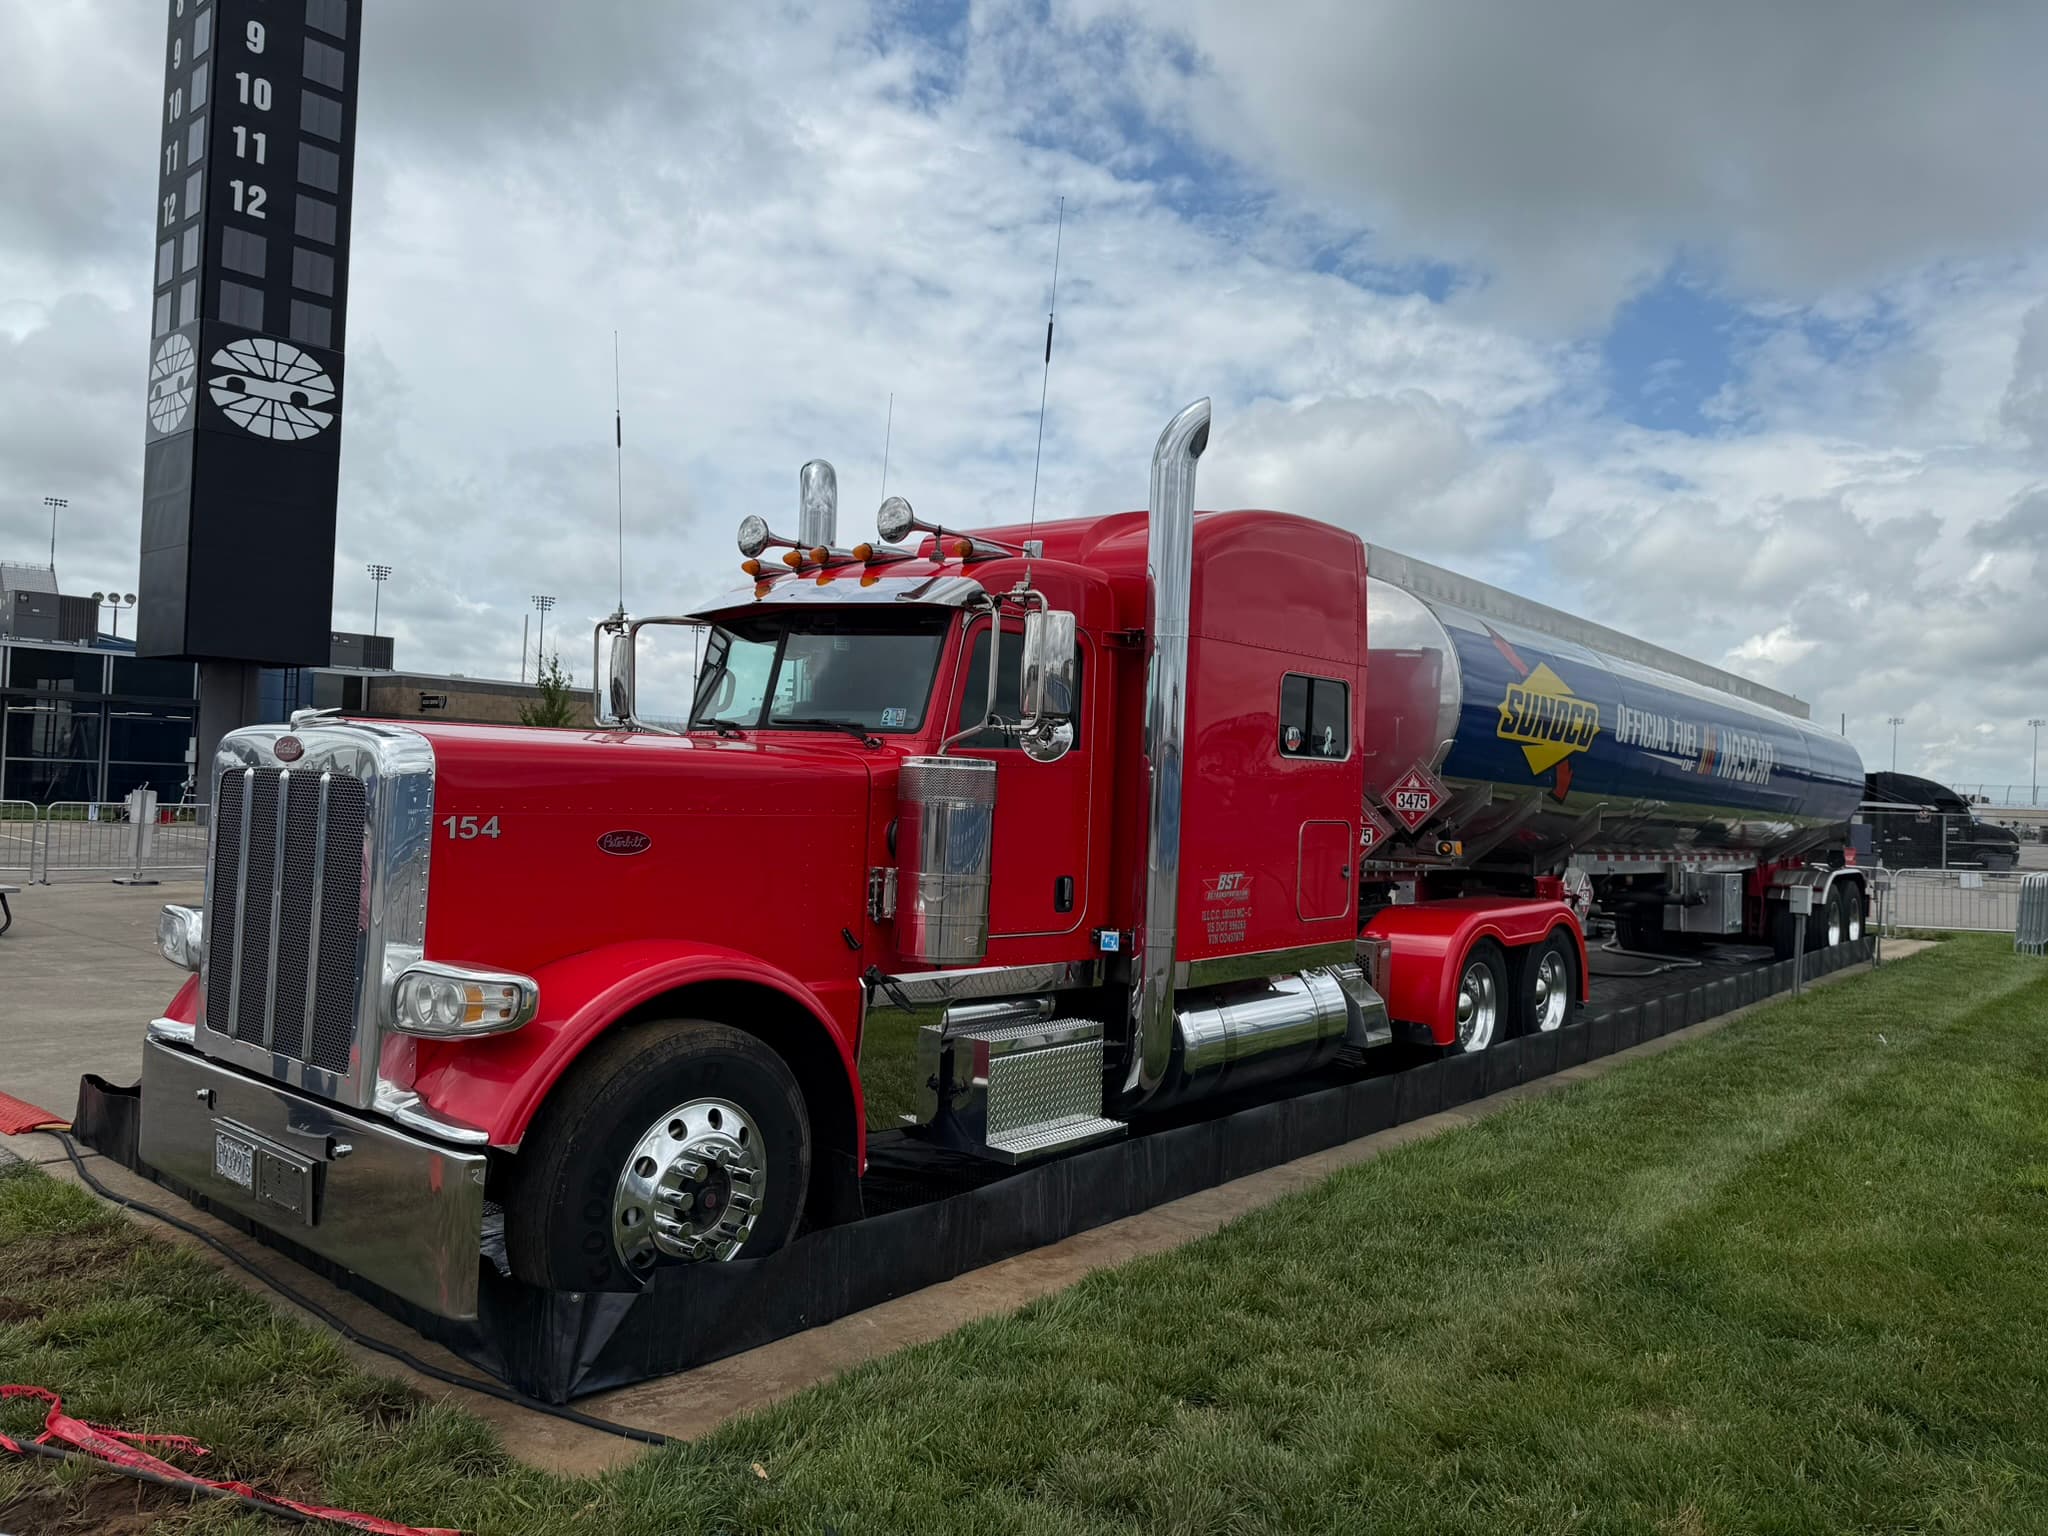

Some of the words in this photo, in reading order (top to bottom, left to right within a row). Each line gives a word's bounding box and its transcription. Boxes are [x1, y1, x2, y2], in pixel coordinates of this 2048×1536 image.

[173, 37, 182, 70] 9
[246, 20, 265, 54] 9
[168, 87, 182, 124] 10
[235, 72, 272, 111] 10
[166, 140, 179, 176] 11
[232, 125, 266, 165] 11
[163, 192, 176, 228] 12
[230, 179, 267, 219] 12
[1500, 688, 1597, 748] SUNOCO
[1615, 703, 1670, 753] OFFICIAL
[1671, 718, 1698, 757] FUEL
[1681, 758, 1697, 772] OF
[1717, 730, 1775, 785] NASCAR
[1397, 792, 1428, 809] 3475
[1409, 811, 1416, 820] 3
[442, 815, 501, 840] 154
[603, 833, 647, 849] Peterbilt
[1217, 873, 1243, 890] BST
